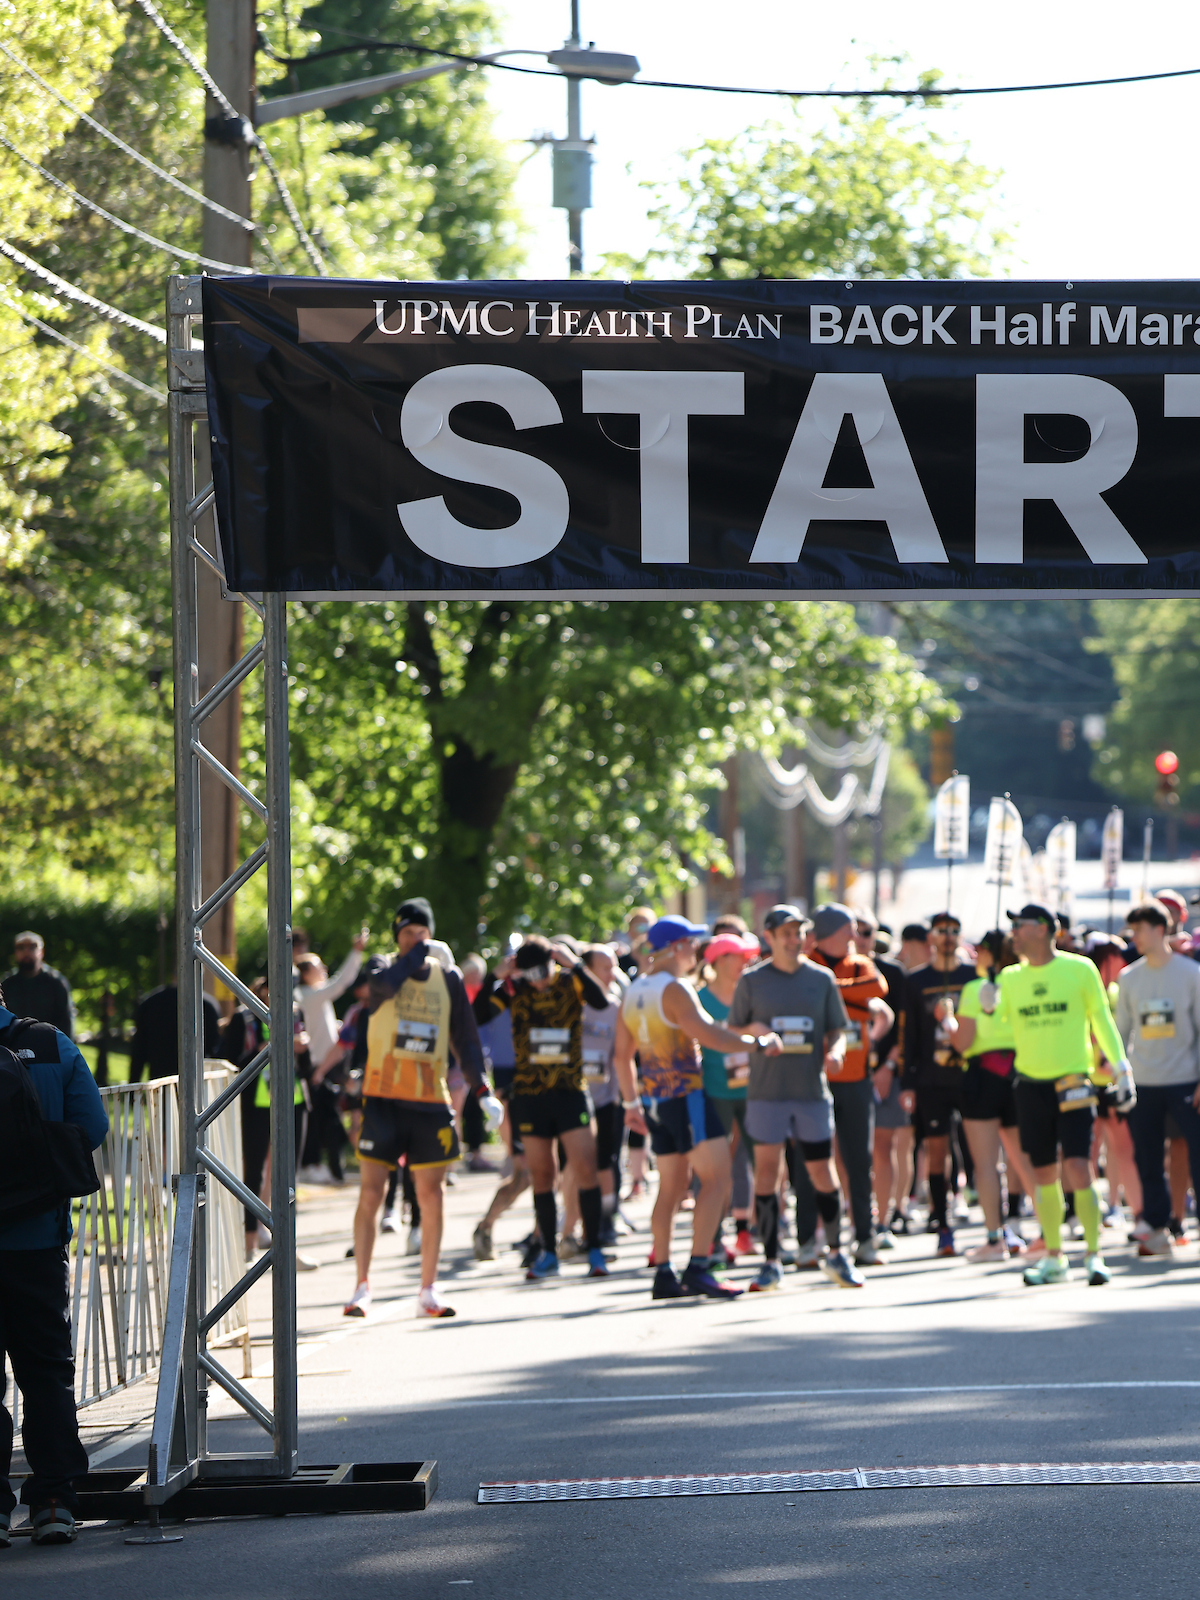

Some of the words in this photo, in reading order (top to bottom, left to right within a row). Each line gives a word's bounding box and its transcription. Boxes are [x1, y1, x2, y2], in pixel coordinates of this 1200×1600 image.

[372, 299, 514, 336] UPMC
[525, 301, 673, 338] HEALTH
[683, 304, 783, 339] PLAN
[809, 304, 957, 345] BACK
[970, 302, 1077, 345] Half
